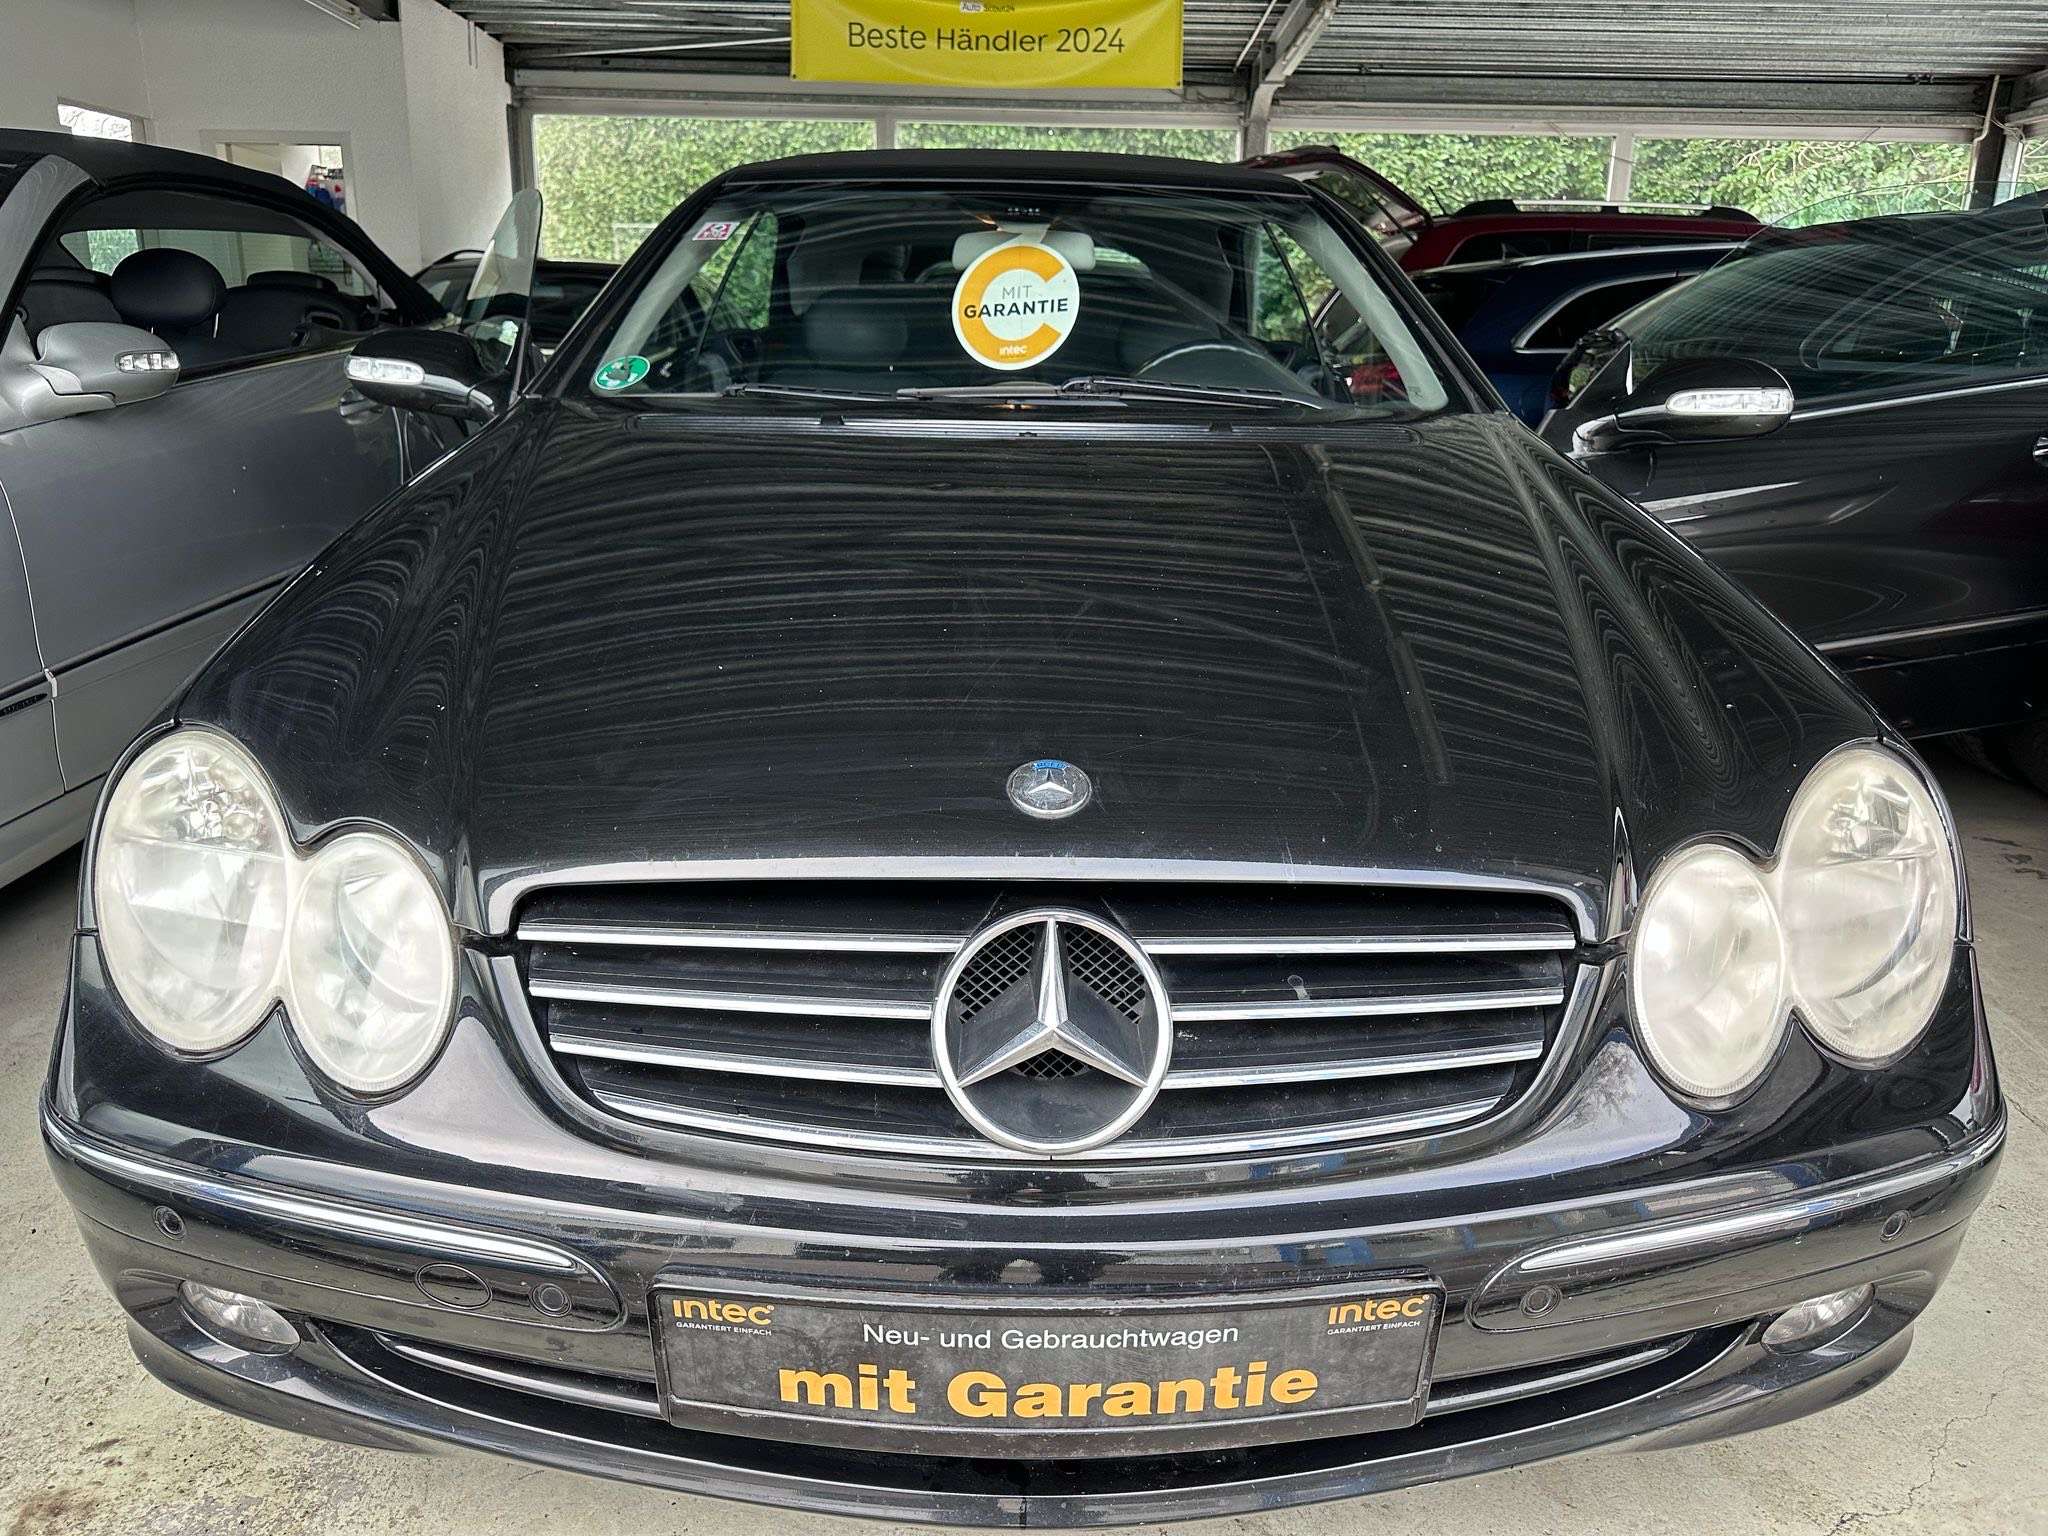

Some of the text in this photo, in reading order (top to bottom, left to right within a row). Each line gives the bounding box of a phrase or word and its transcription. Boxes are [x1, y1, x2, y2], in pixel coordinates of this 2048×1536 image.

[848, 22, 1125, 53] Beste Händler 2024
[1002, 285, 1032, 299] MIT
[964, 298, 1069, 319] GARANTIE
[676, 1321, 772, 1336] GARANTIERT EINFACH
[863, 1324, 1239, 1350] Neu- und Gebrauchtwagen
[1327, 1320, 1421, 1335] GARANTIERT EINFACH
[778, 1361, 1318, 1418] mit Garantie
